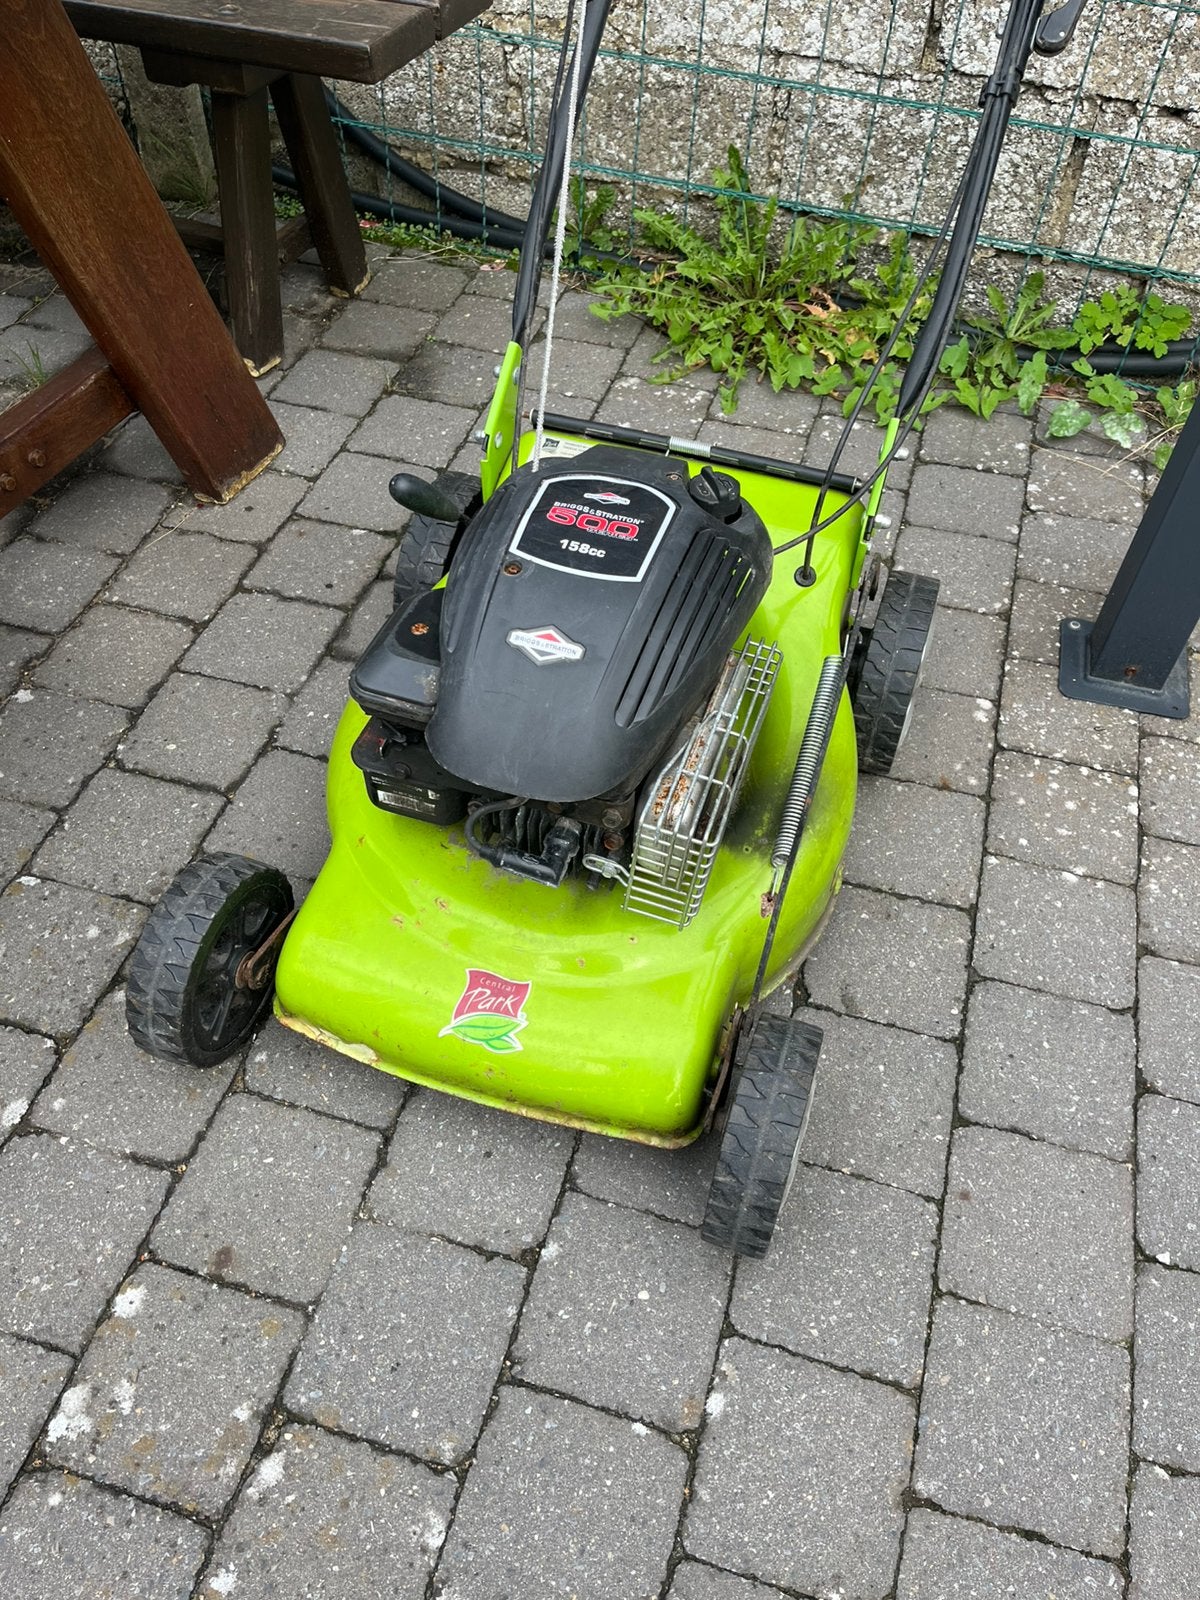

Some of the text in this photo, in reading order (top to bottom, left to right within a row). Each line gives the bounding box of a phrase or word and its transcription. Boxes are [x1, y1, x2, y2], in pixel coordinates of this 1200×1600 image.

[546, 506, 640, 539] 500
[559, 539, 606, 558] 158cc
[480, 977, 516, 993] Central
[465, 987, 520, 1017] Park
